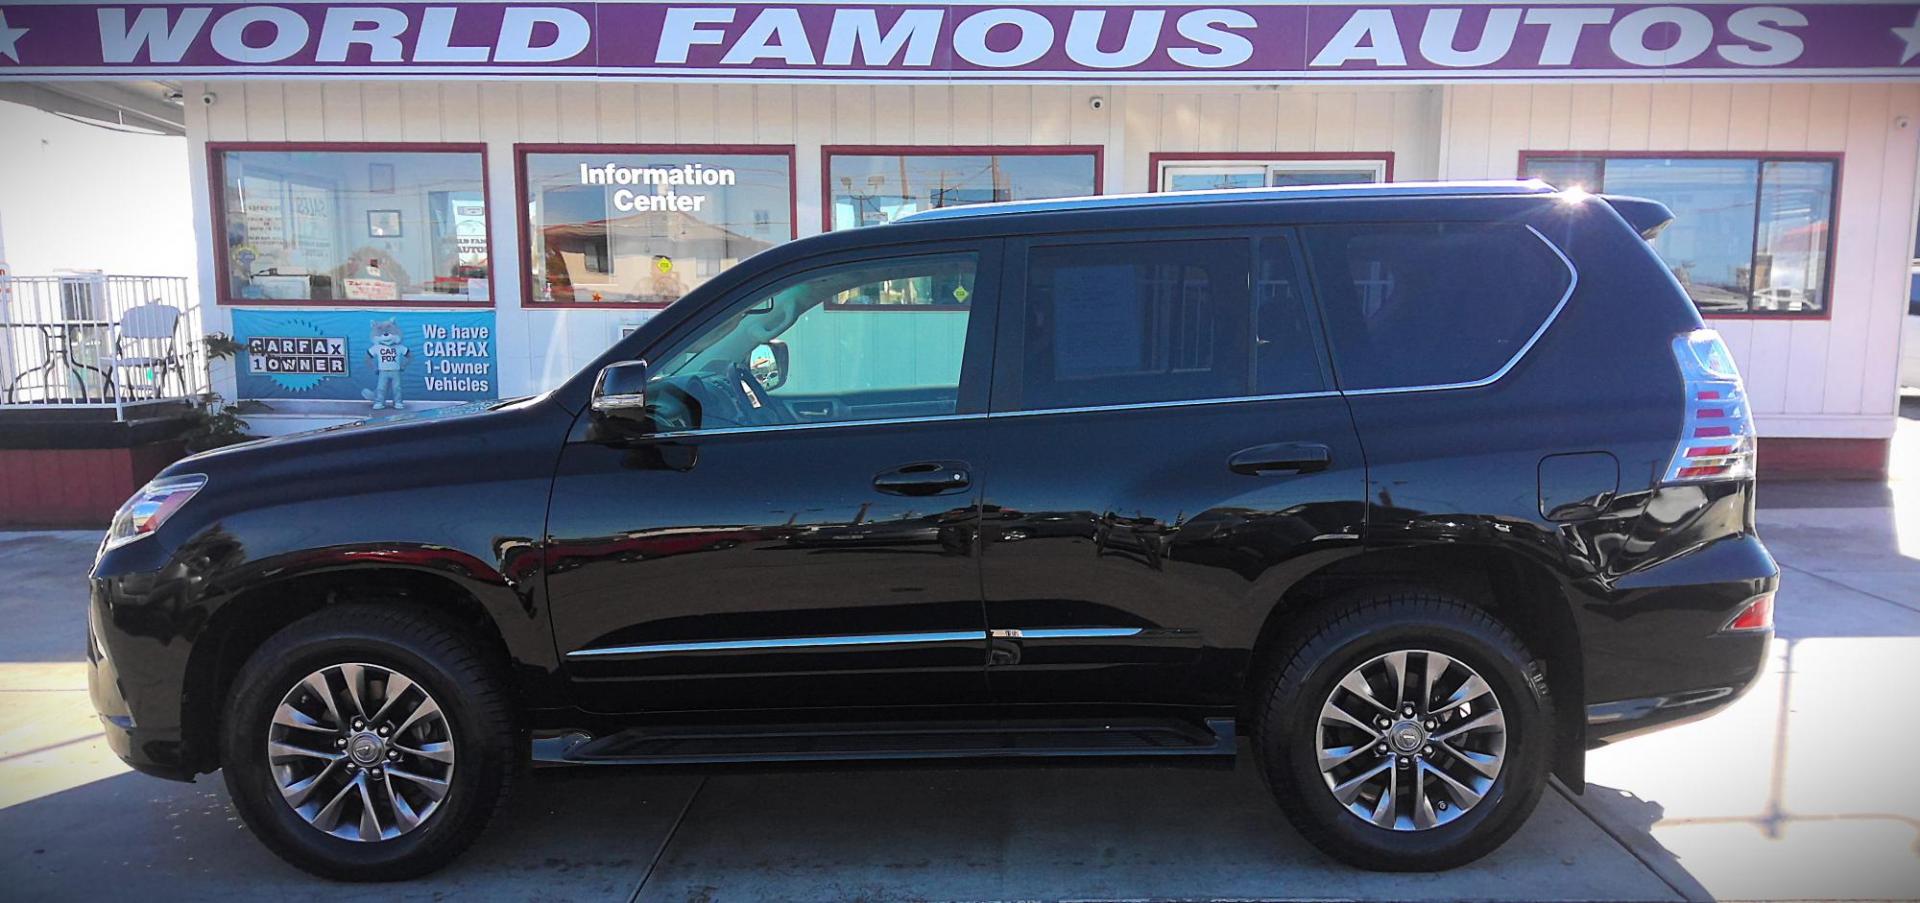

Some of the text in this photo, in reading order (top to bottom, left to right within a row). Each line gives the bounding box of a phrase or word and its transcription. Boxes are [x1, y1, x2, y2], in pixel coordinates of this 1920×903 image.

[97, 6, 1809, 68] WORLD FAMOUS AUTOS
[580, 163, 736, 186] Information
[613, 189, 706, 212] Center
[422, 324, 488, 339] We have
[251, 340, 342, 354] CARFAX
[423, 341, 489, 357] CARFAX
[424, 359, 490, 375] 1-Owner
[424, 376, 489, 392] Vehicles
